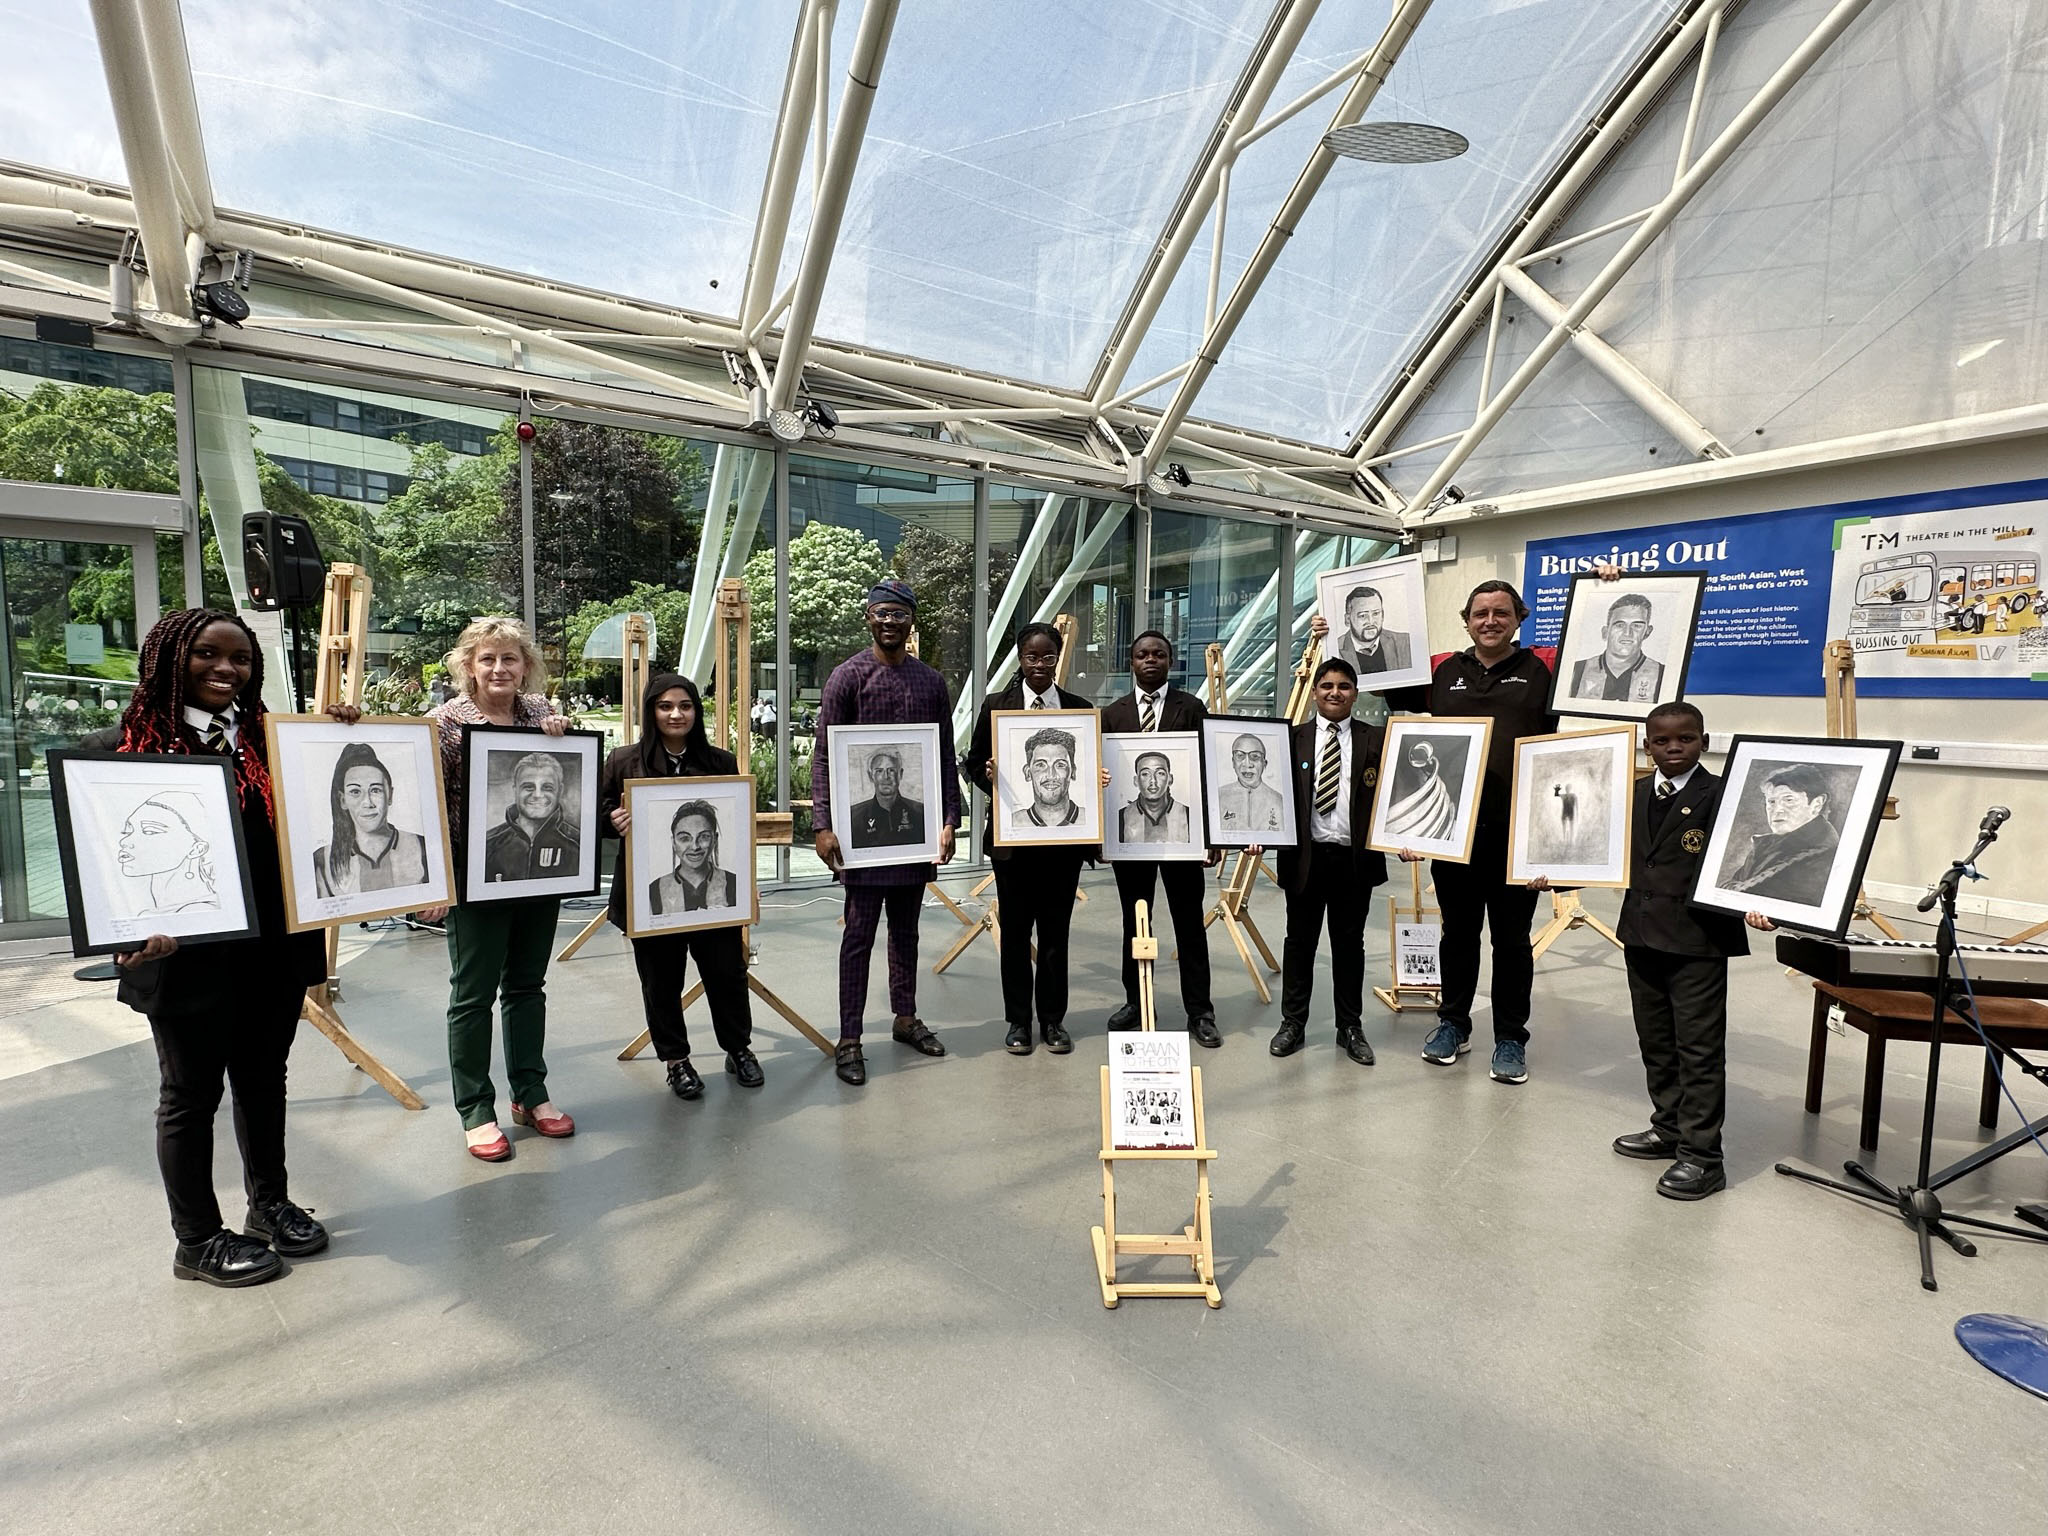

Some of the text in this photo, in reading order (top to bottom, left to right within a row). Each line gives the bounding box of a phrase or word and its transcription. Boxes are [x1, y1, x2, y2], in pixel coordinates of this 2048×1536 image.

[1906, 531, 1950, 542] THEATRE
[1953, 530, 1965, 538] IN
[1968, 528, 1988, 537] THE
[1991, 525, 2018, 535] MILL
[1539, 536, 1730, 577] Bussing Out
[1720, 572, 1747, 582] South
[1749, 570, 1777, 580] Asian,
[1779, 568, 1805, 578] West
[1728, 583, 1737, 592] in
[1739, 582, 1754, 590] the
[1756, 580, 1776, 589] 60's
[1777, 580, 1788, 588] or
[1789, 578, 1809, 587] 70's
[1732, 607, 1750, 616] piece
[1768, 623, 1798, 631] children
[1762, 639, 1772, 647] by
[1855, 632, 1922, 650] BUSSING OUT
